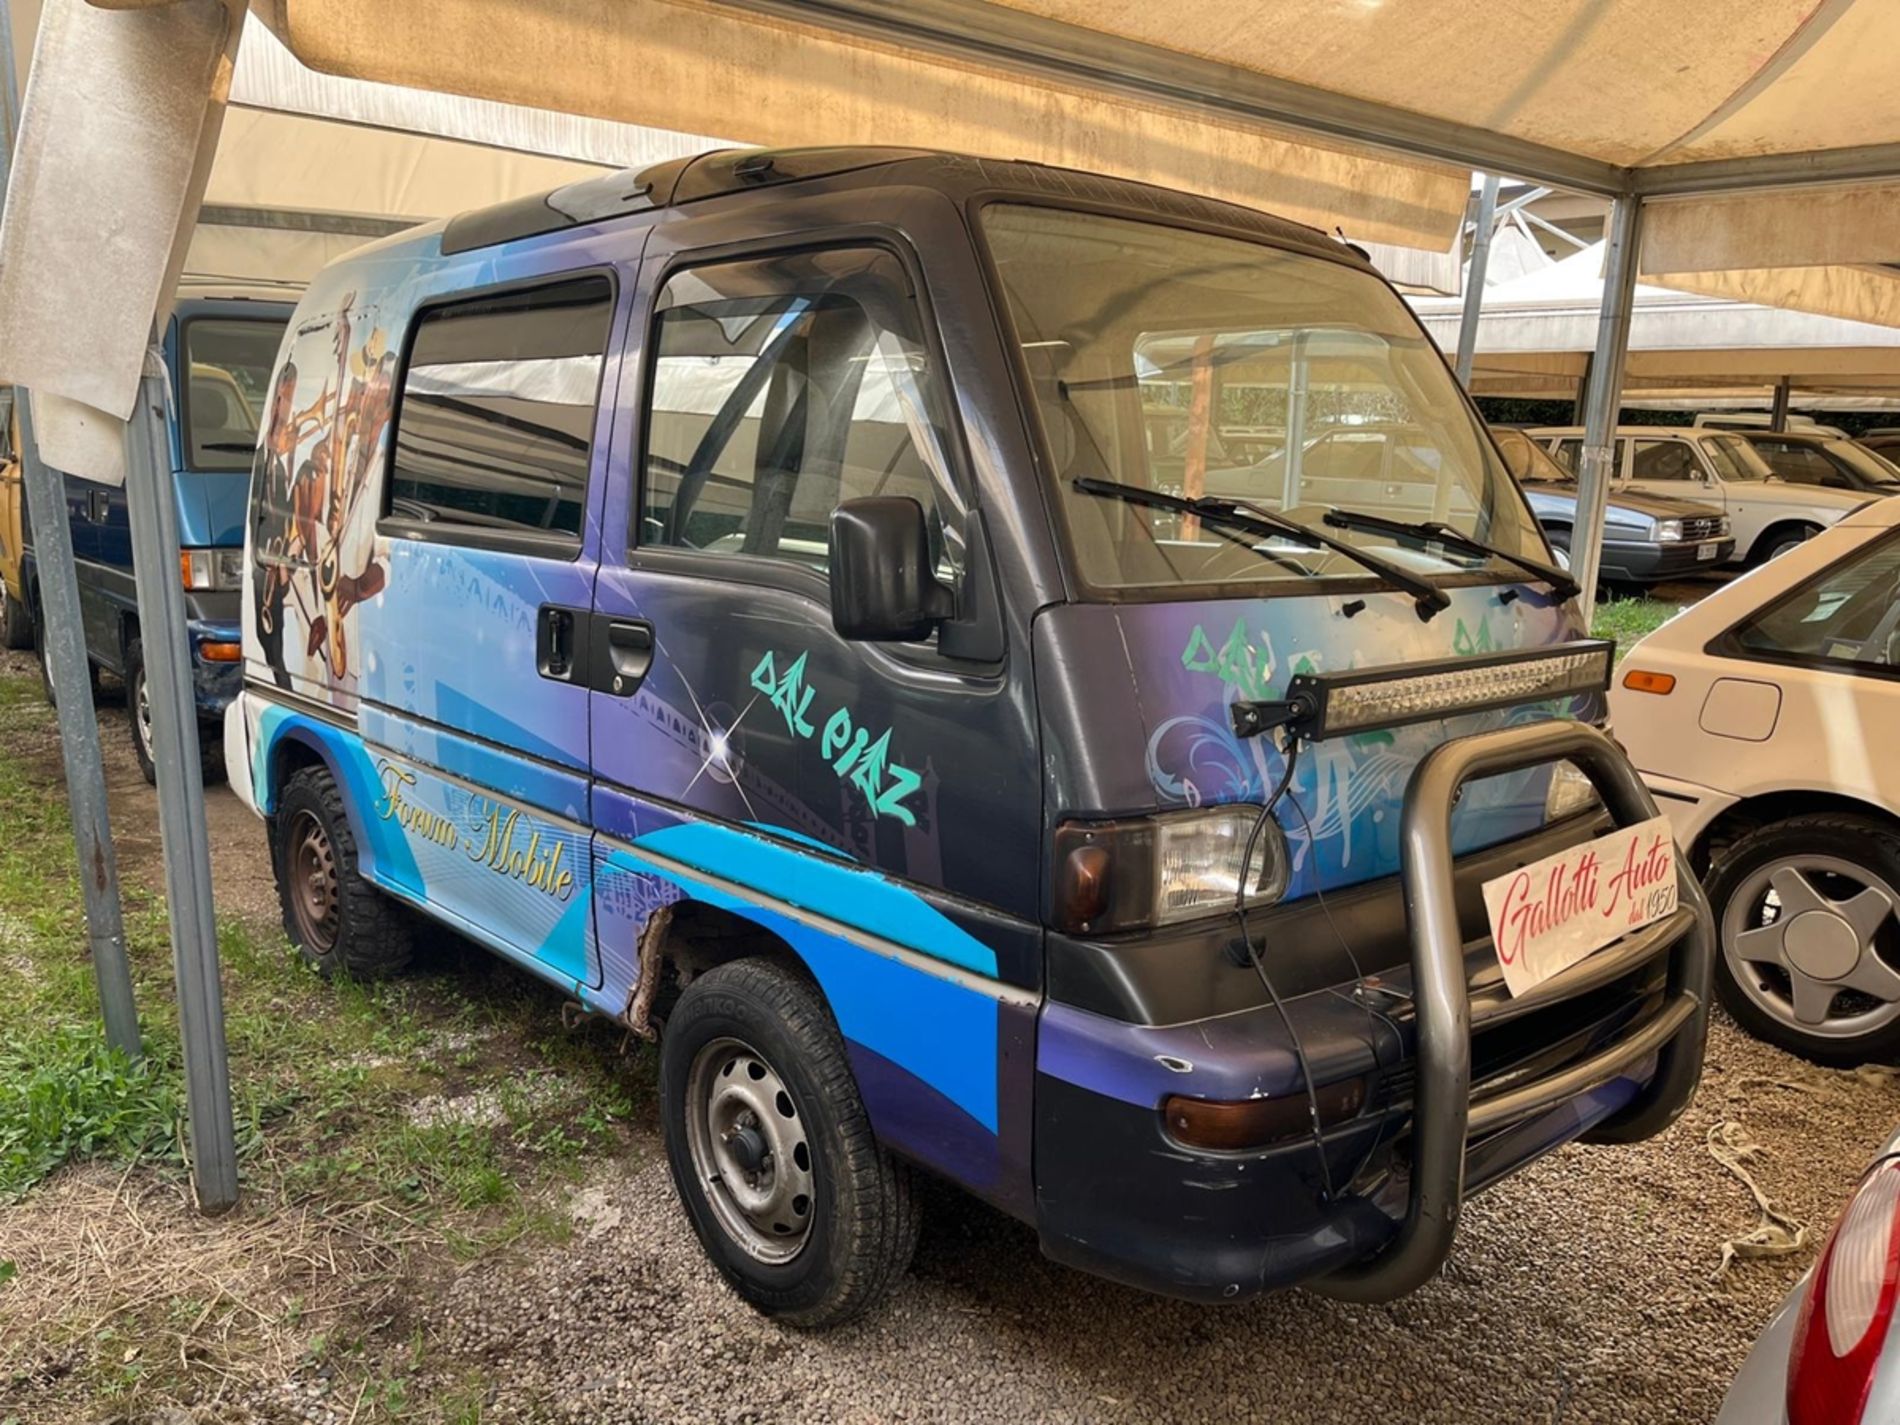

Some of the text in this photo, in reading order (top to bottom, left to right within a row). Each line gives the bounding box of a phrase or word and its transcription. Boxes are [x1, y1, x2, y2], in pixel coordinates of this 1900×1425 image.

[751, 650, 816, 738] DAL
[375, 758, 574, 900] Forum Mobile
[1498, 834, 1670, 971] Gallotti Auto
[1646, 885, 1676, 919] 1950
